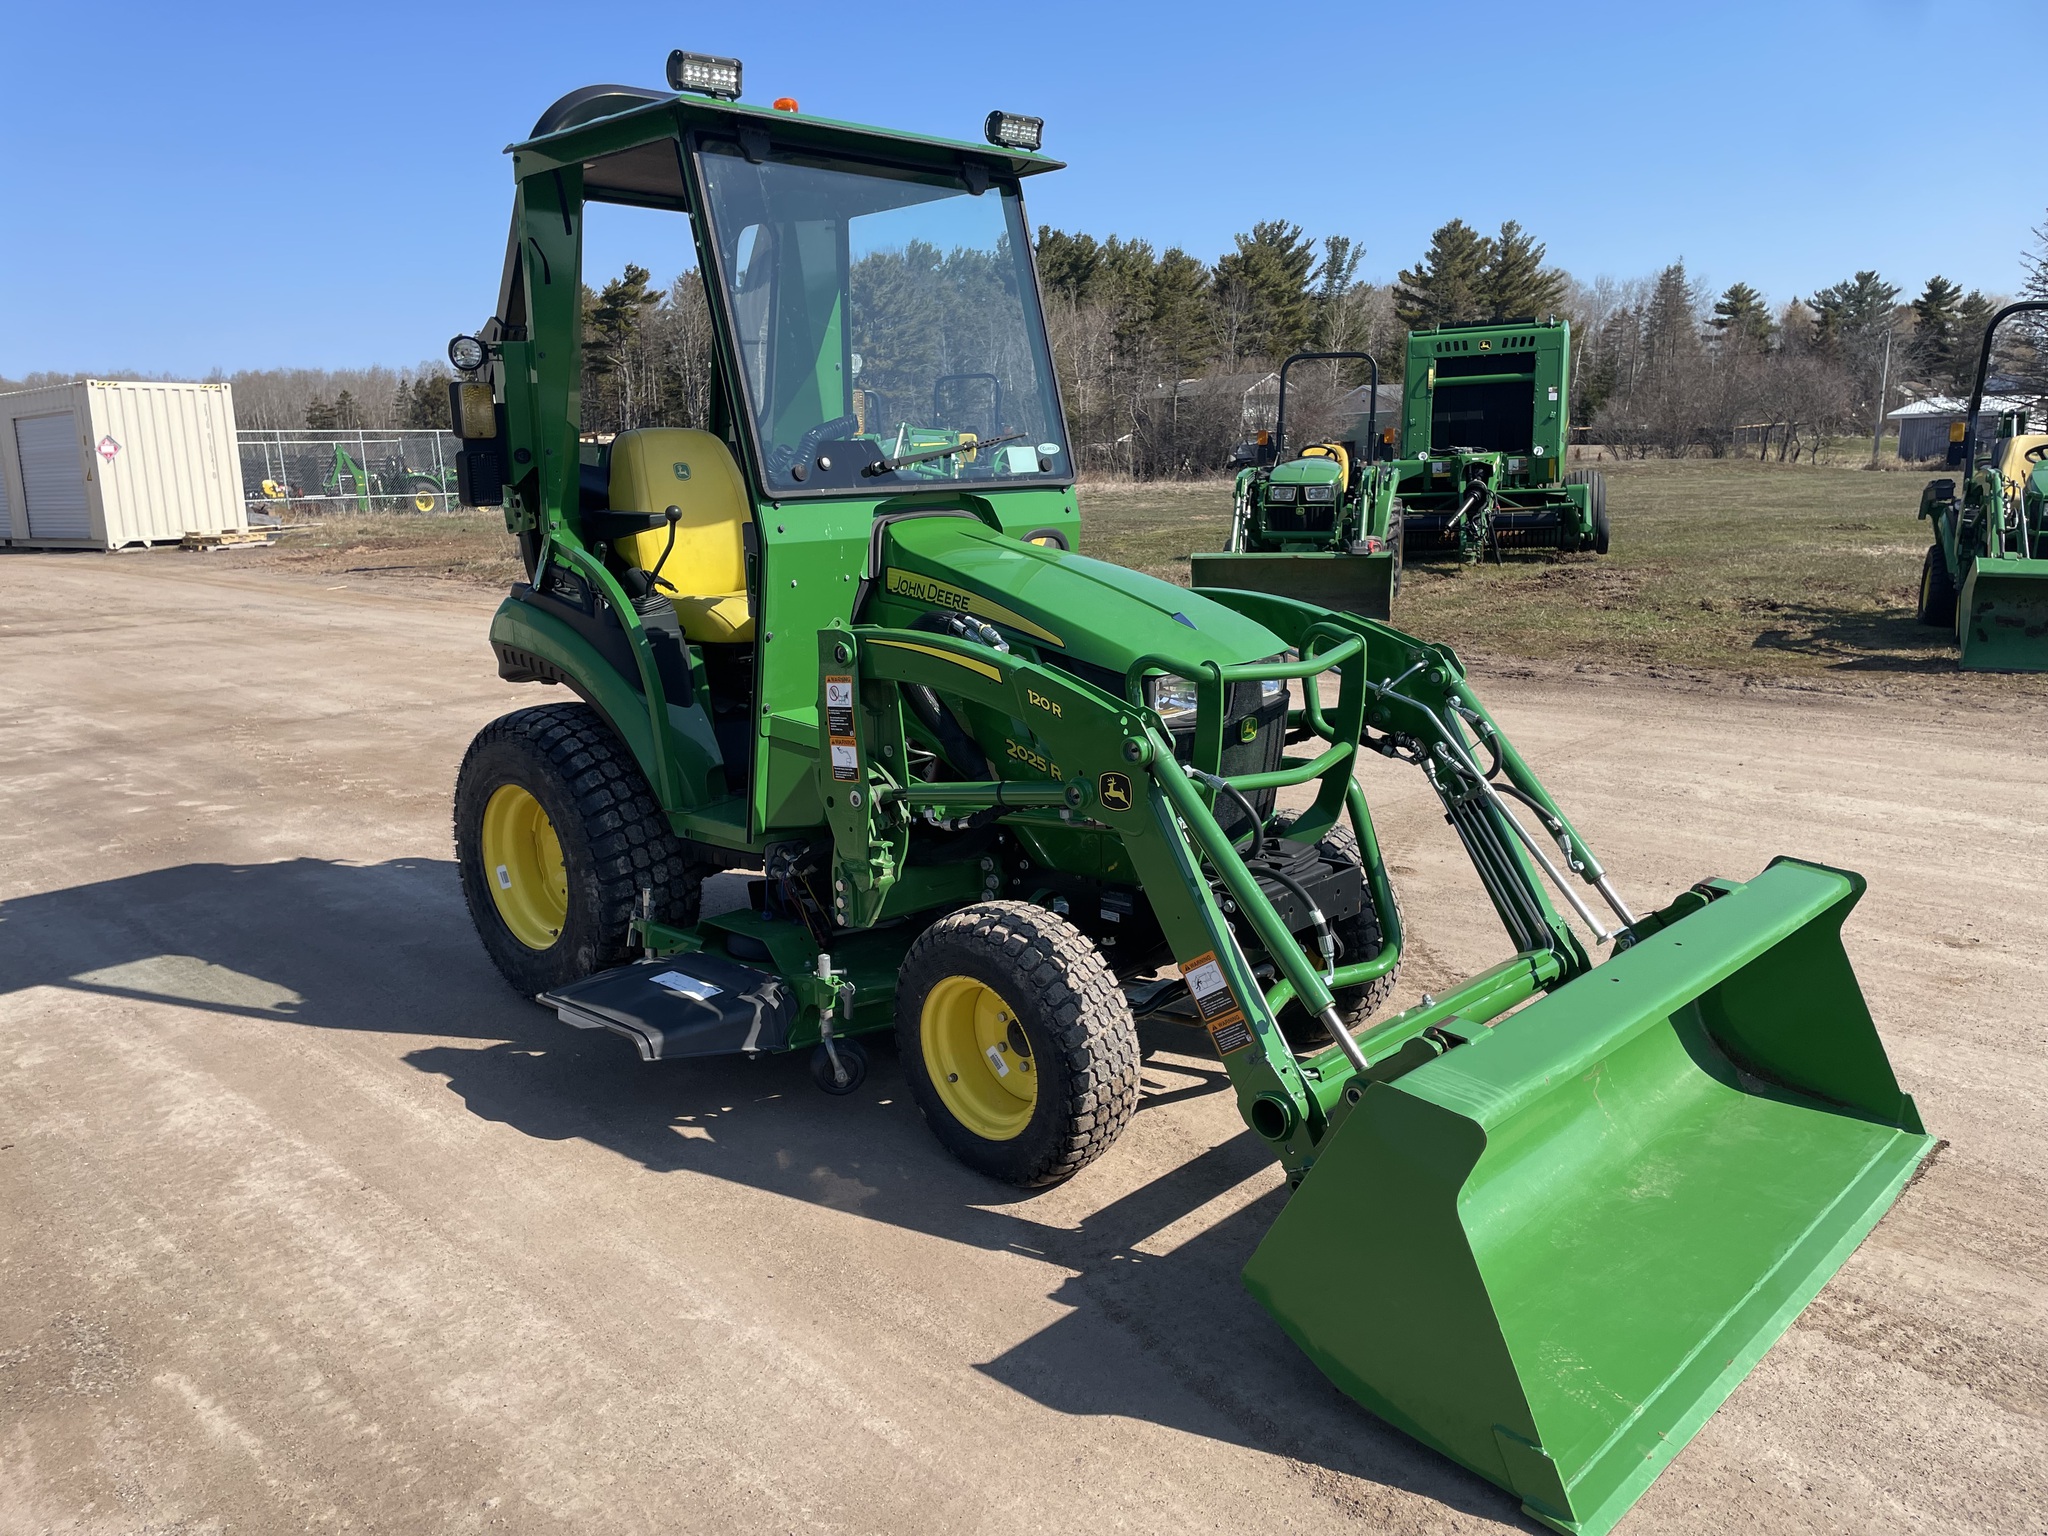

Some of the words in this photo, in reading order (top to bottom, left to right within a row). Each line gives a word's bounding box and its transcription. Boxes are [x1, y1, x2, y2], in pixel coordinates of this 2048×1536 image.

[893, 576, 925, 598] JOHN
[927, 584, 970, 610] DEERE
[1027, 688, 1051, 711] 120
[1052, 702, 1062, 718] R
[1006, 738, 1047, 772] 2025
[1050, 763, 1062, 781] R
[1190, 955, 1212, 968] WARNING
[1218, 1015, 1240, 1028] WARNING
